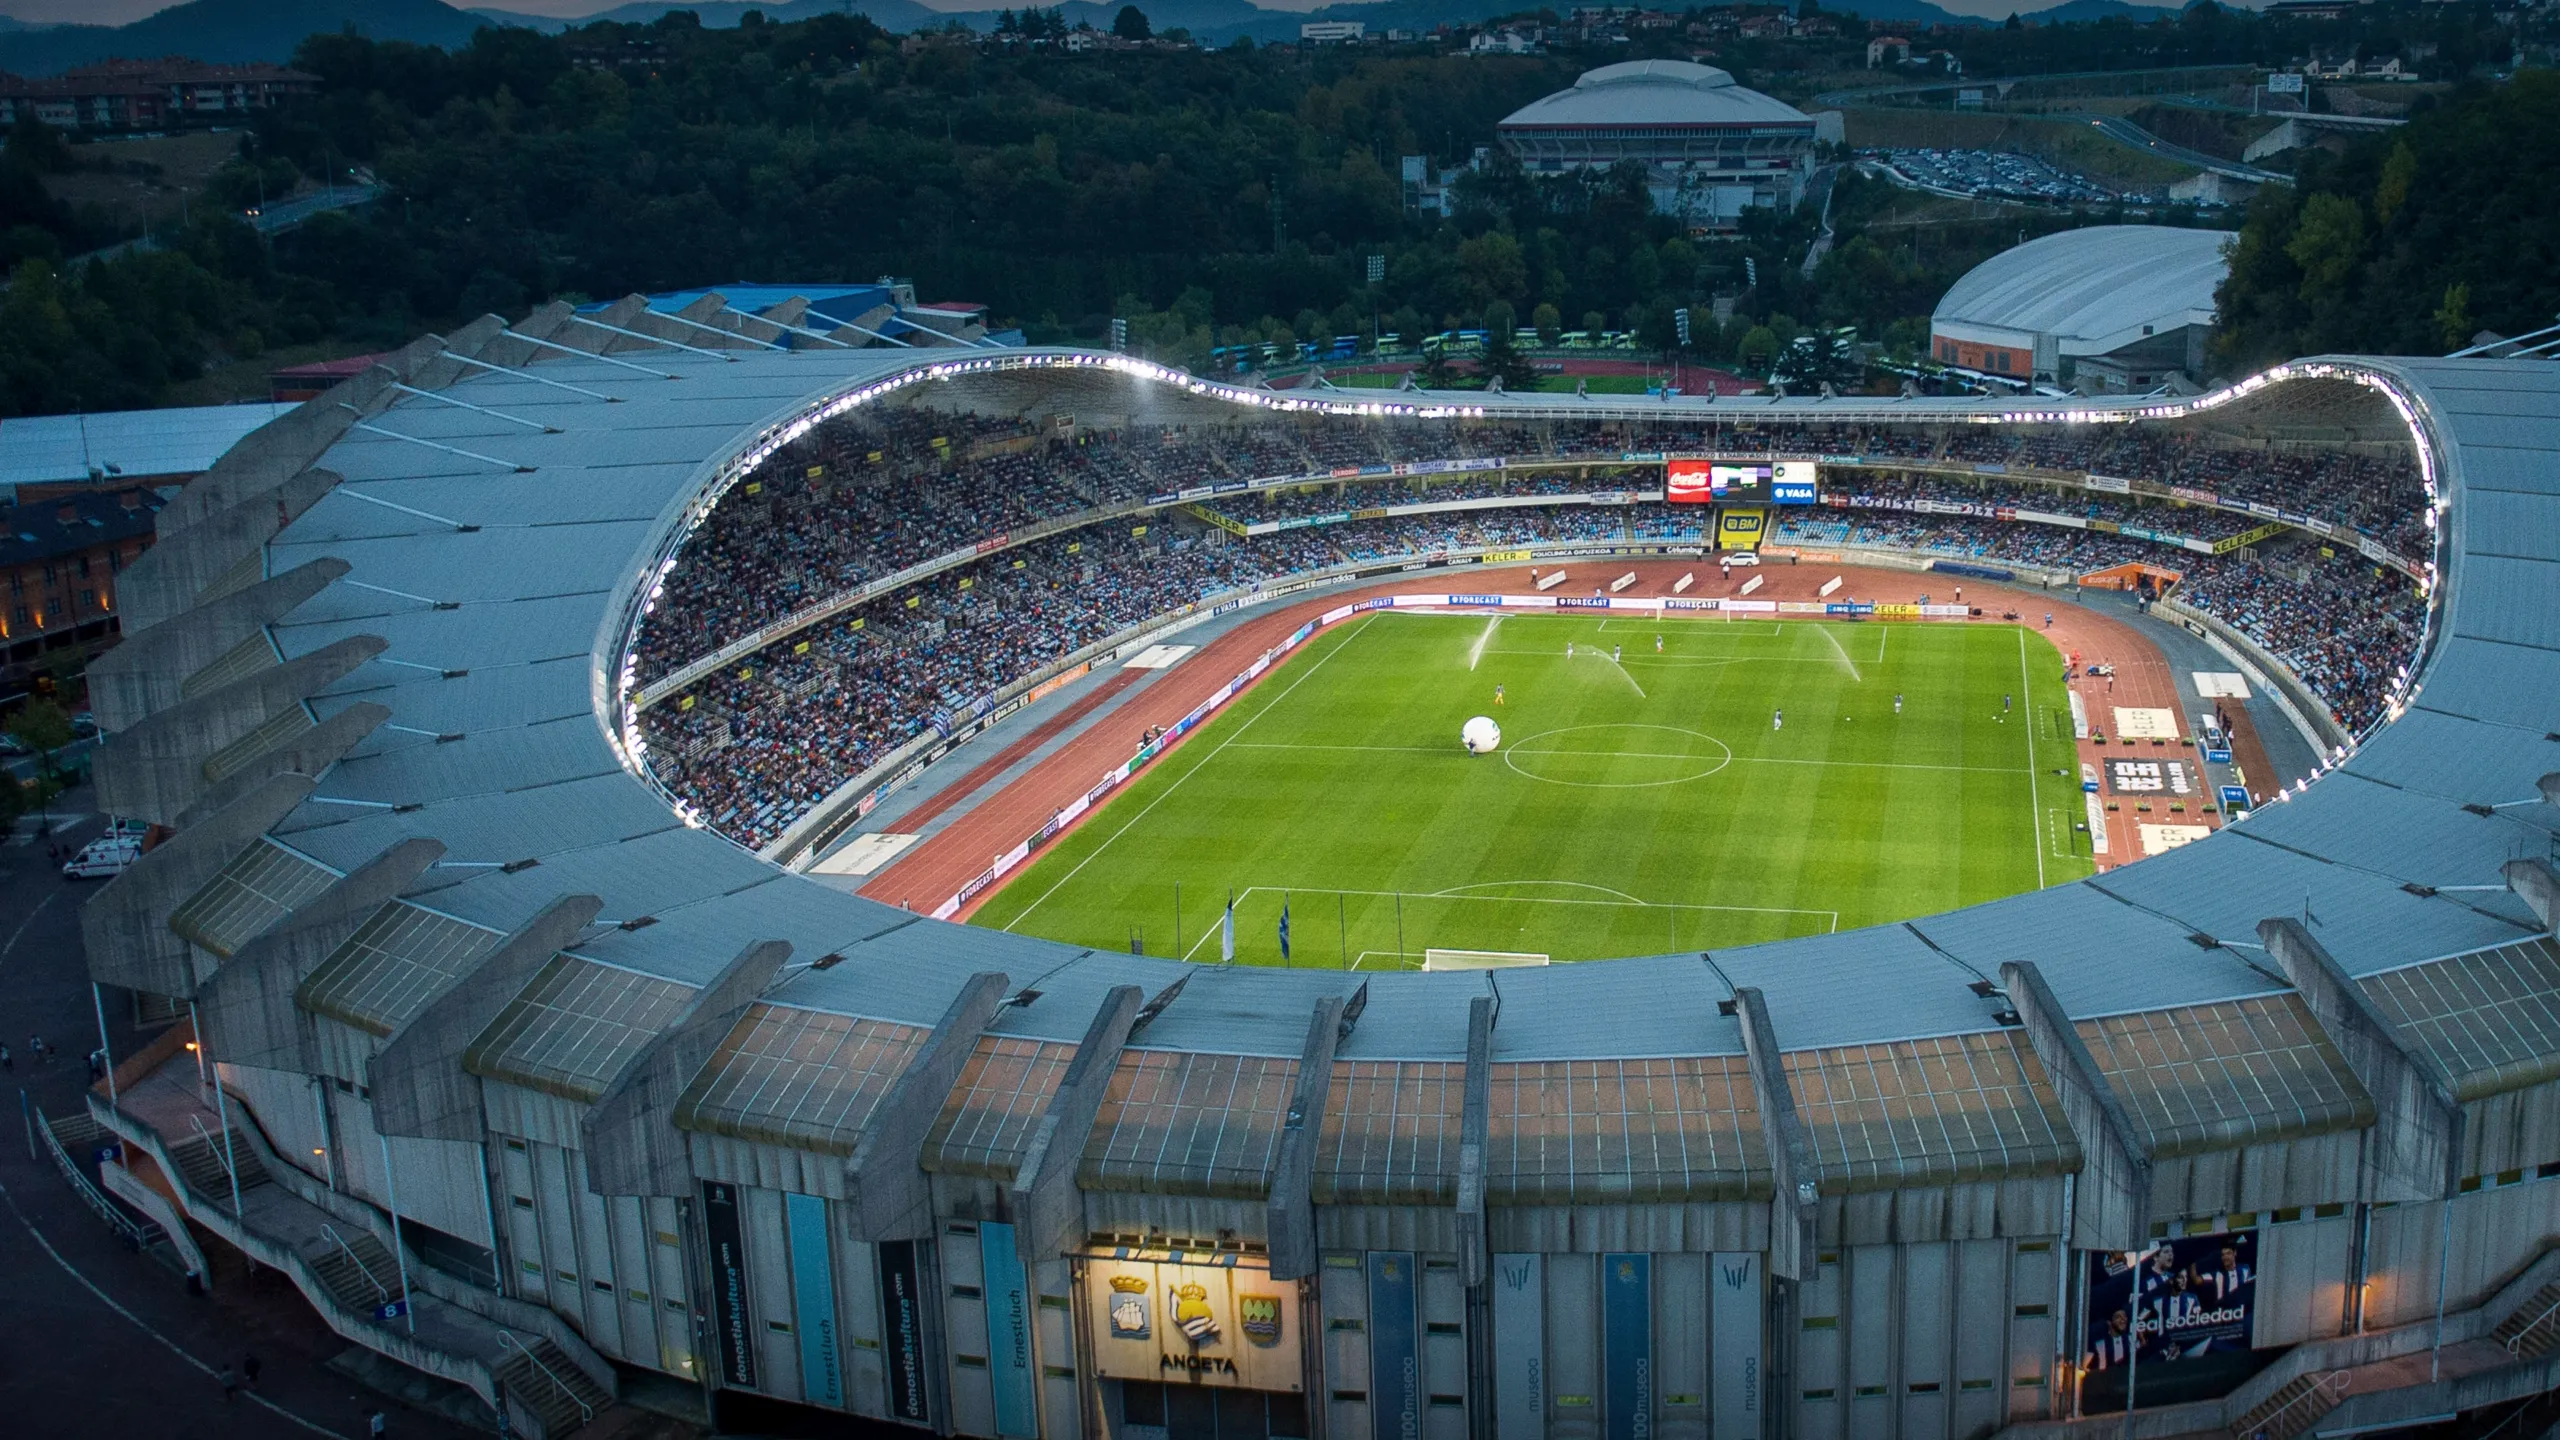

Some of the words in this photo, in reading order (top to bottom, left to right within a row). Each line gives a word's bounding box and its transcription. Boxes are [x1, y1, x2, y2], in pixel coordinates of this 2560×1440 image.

[1785, 489, 1813, 498] VASA
[1204, 510, 1240, 532] KELER
[1739, 519, 1758, 529] BM
[2213, 532, 2254, 554] KELER
[1485, 552, 1516, 562] KELER
[1573, 548, 1611, 556] GIPUZKOA
[1403, 563, 1427, 572] CANAL+
[1447, 557, 1473, 566] CANAL+
[1332, 573, 1356, 584] adidas
[1220, 600, 1238, 613] VASA
[1359, 598, 1392, 611] FORECAST
[1459, 596, 1500, 605] FORECAST
[1566, 598, 1608, 607] FORECAST
[1676, 601, 1717, 609] FORECAST
[1874, 605, 1907, 614] KELER
[1093, 775, 1115, 799] FORECAST
[965, 869, 994, 899] FORECAST
[102, 1148, 112, 1160] 9
[384, 1304, 397, 1318] 8
[721, 1241, 748, 1384] donostiakultura.com
[2166, 1304, 2245, 1329] sociedad
[894, 1272, 918, 1418] donostiakultura.com
[1160, 1353, 1237, 1376] ANOETA
[1528, 1357, 1540, 1412] museoa
[1745, 1357, 1756, 1412] museoa
